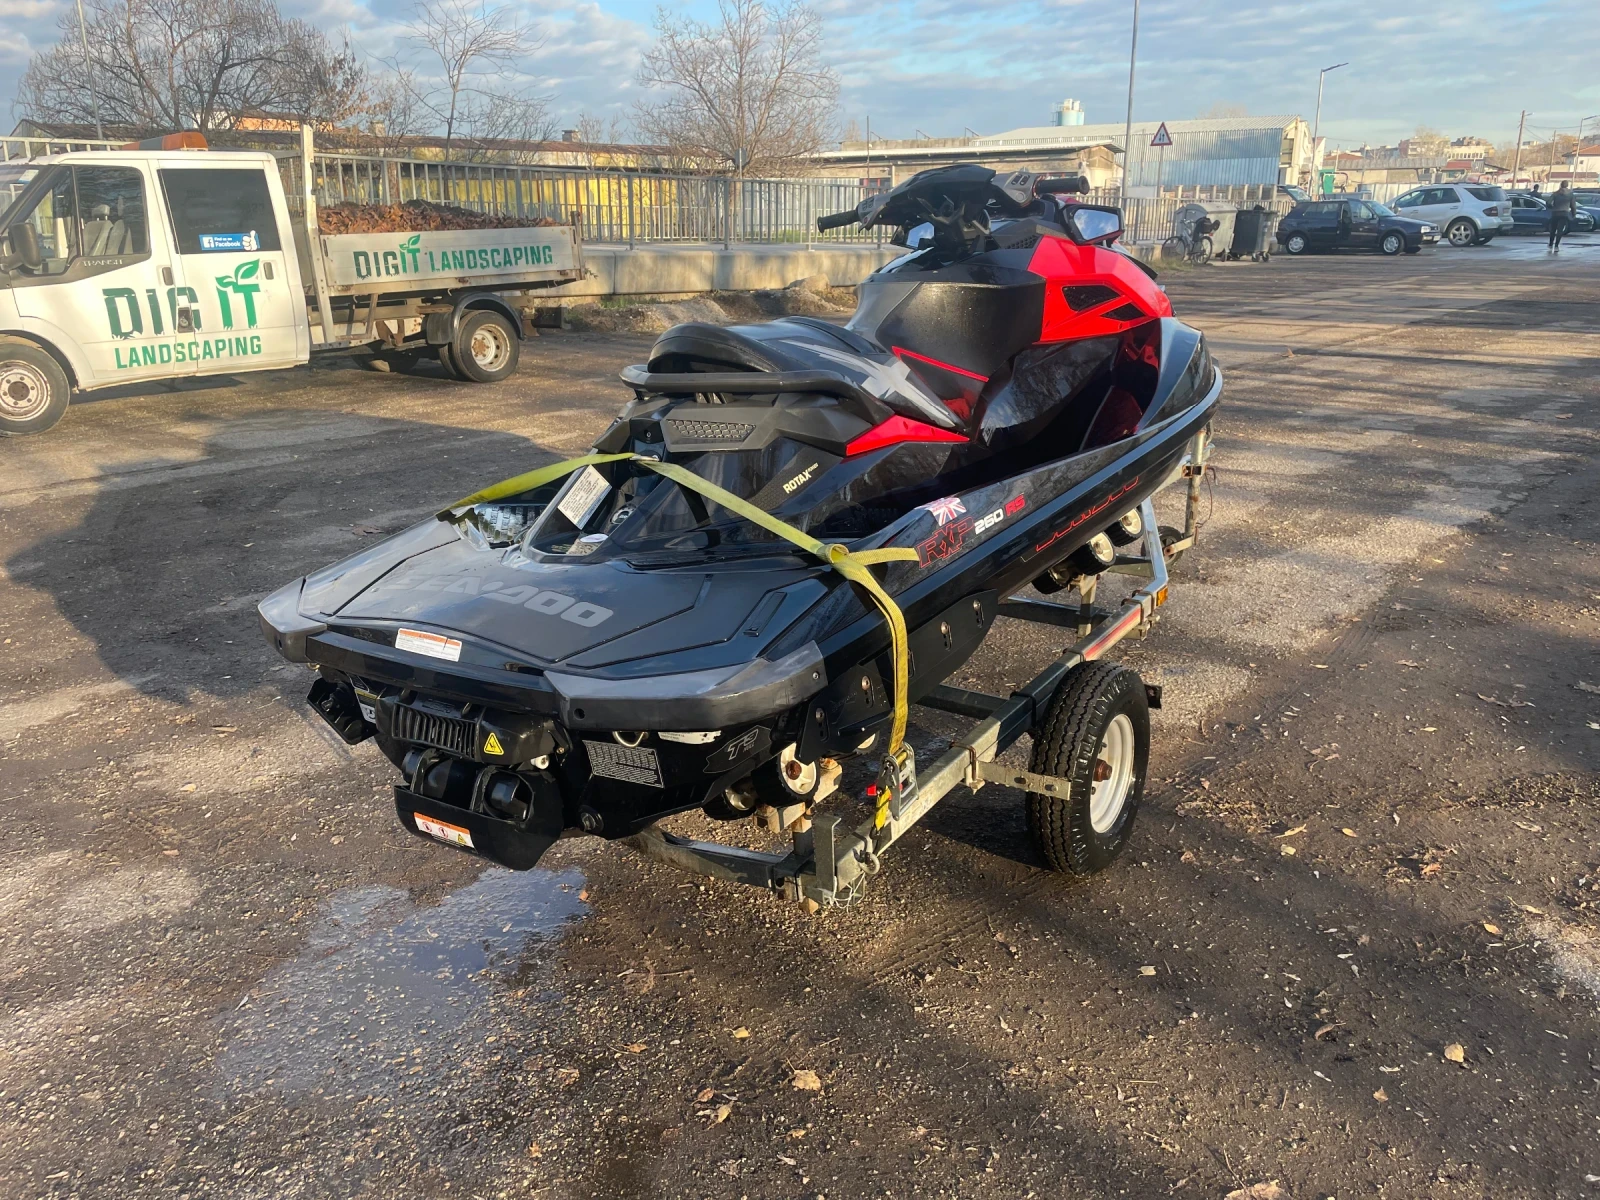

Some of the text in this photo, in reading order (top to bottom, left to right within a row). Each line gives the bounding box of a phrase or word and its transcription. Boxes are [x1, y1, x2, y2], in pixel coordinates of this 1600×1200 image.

[428, 245, 553, 273] LANDSCAPING
[102, 275, 262, 340] DIG IT
[114, 335, 262, 369] LANDSCAPING
[782, 469, 812, 494] ROTAX
[974, 508, 1004, 535] 260
[1004, 493, 1026, 517] RS
